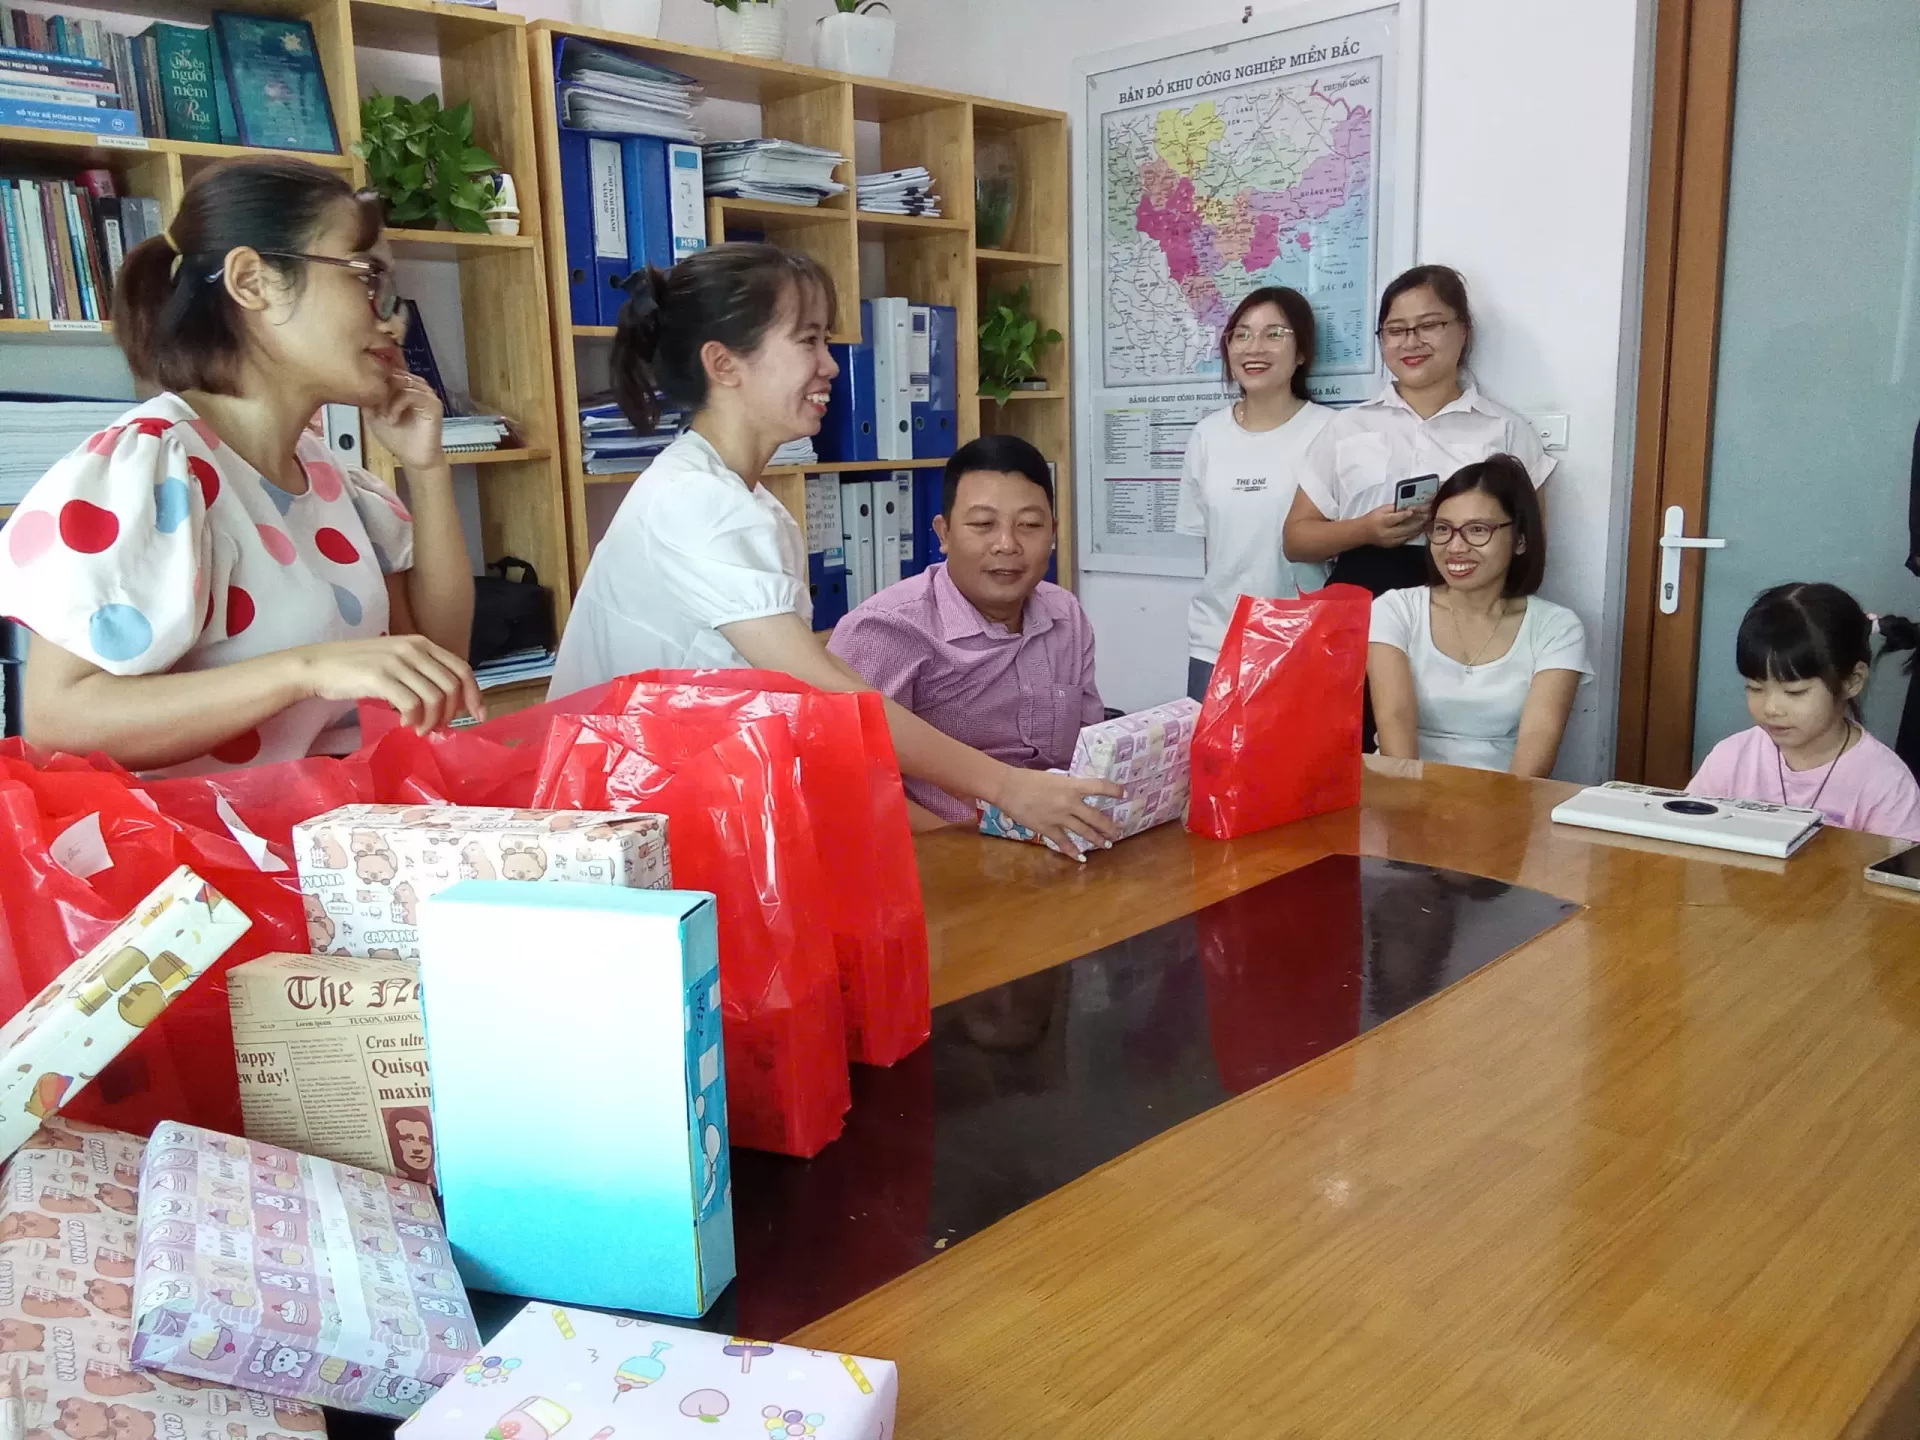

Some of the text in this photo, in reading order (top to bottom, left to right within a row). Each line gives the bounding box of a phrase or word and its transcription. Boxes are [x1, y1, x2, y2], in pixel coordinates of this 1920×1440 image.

[1119, 37, 1360, 104] BẢN ĐỒ KHU CÔNG NGHIỆP MIỀN BẮC
[681, 238, 698, 248] HSB
[1236, 477, 1267, 486] THE ONE
[284, 975, 354, 1014] The
[366, 1033, 426, 1049] Cras ultr
[257, 1068, 290, 1087] day!
[53, 1325, 78, 1382] CAPYBARA
